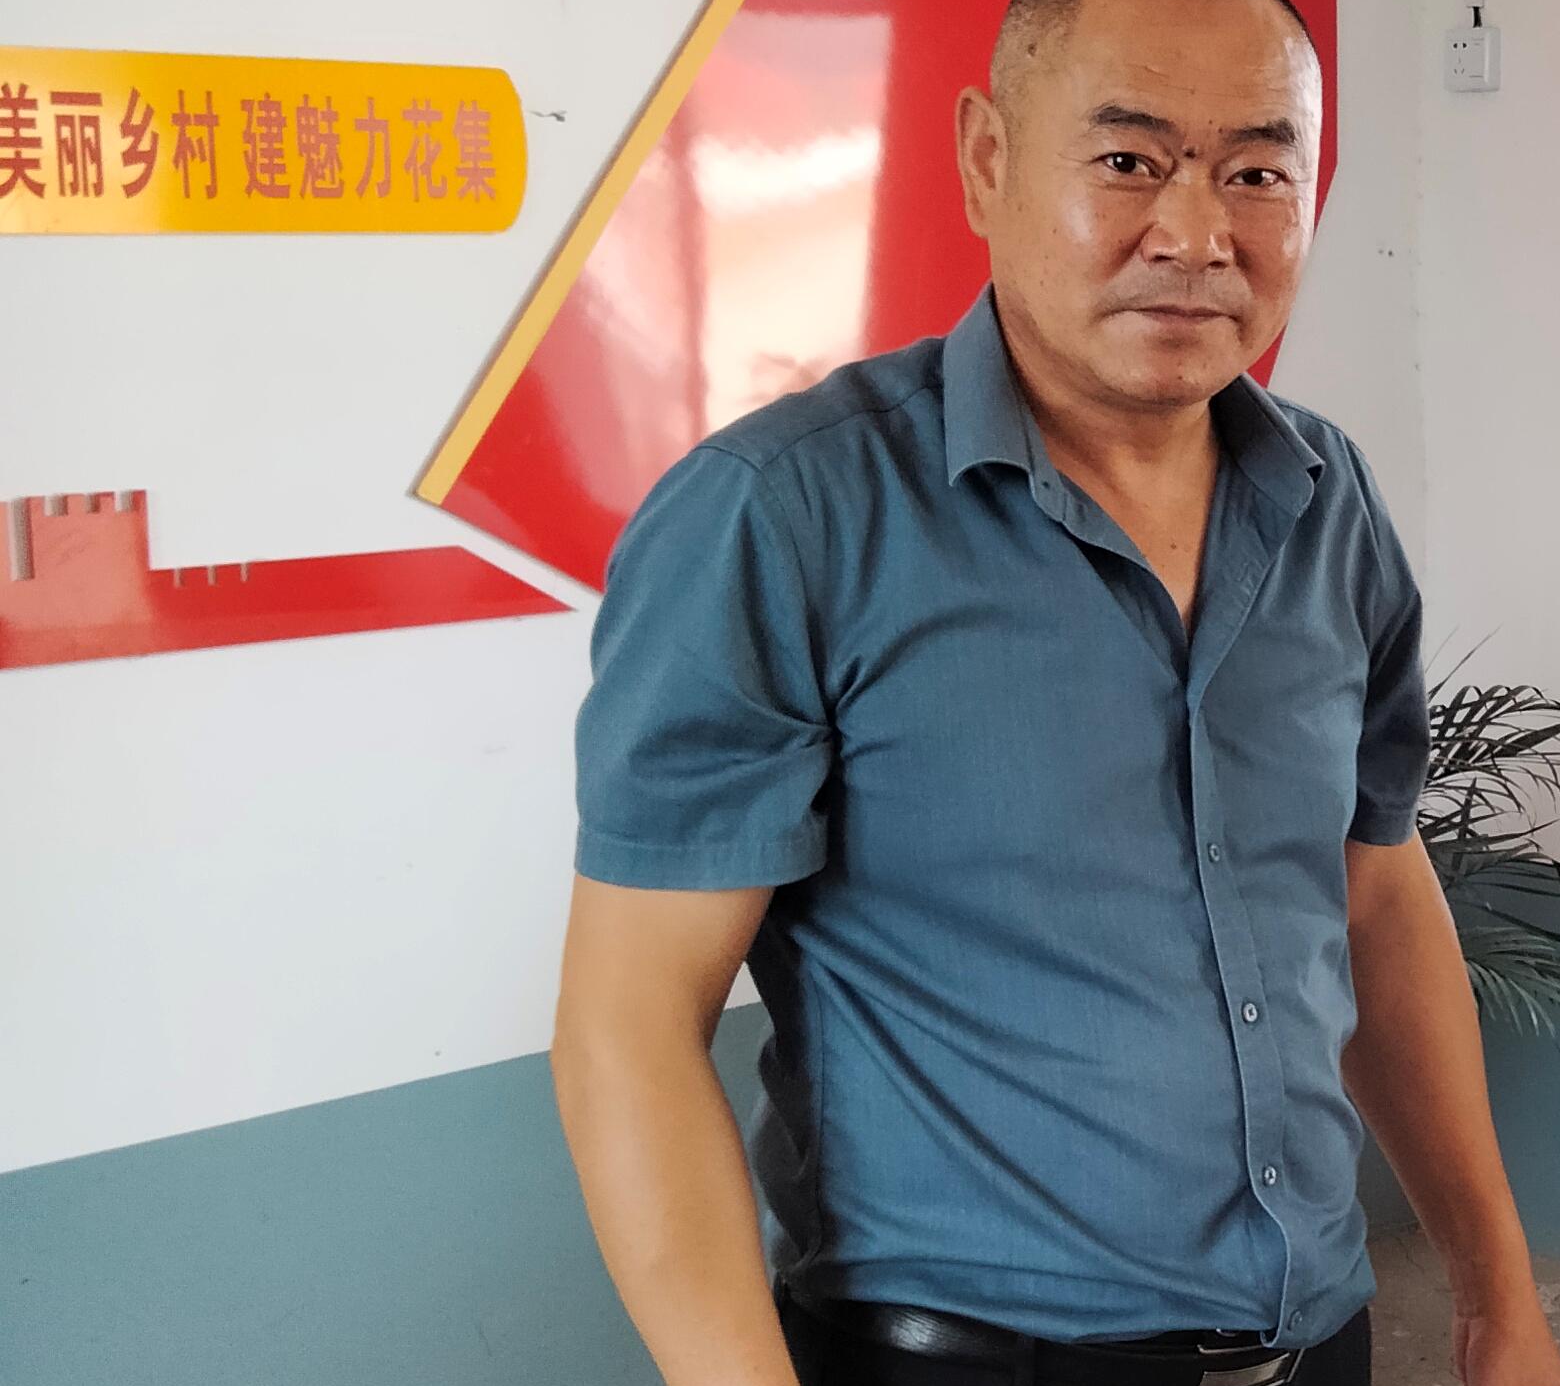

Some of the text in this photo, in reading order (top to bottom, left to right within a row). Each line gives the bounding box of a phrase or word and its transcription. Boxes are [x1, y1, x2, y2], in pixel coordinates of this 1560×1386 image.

[0, 84, 498, 203] 美丽乡村 建魅力花集
